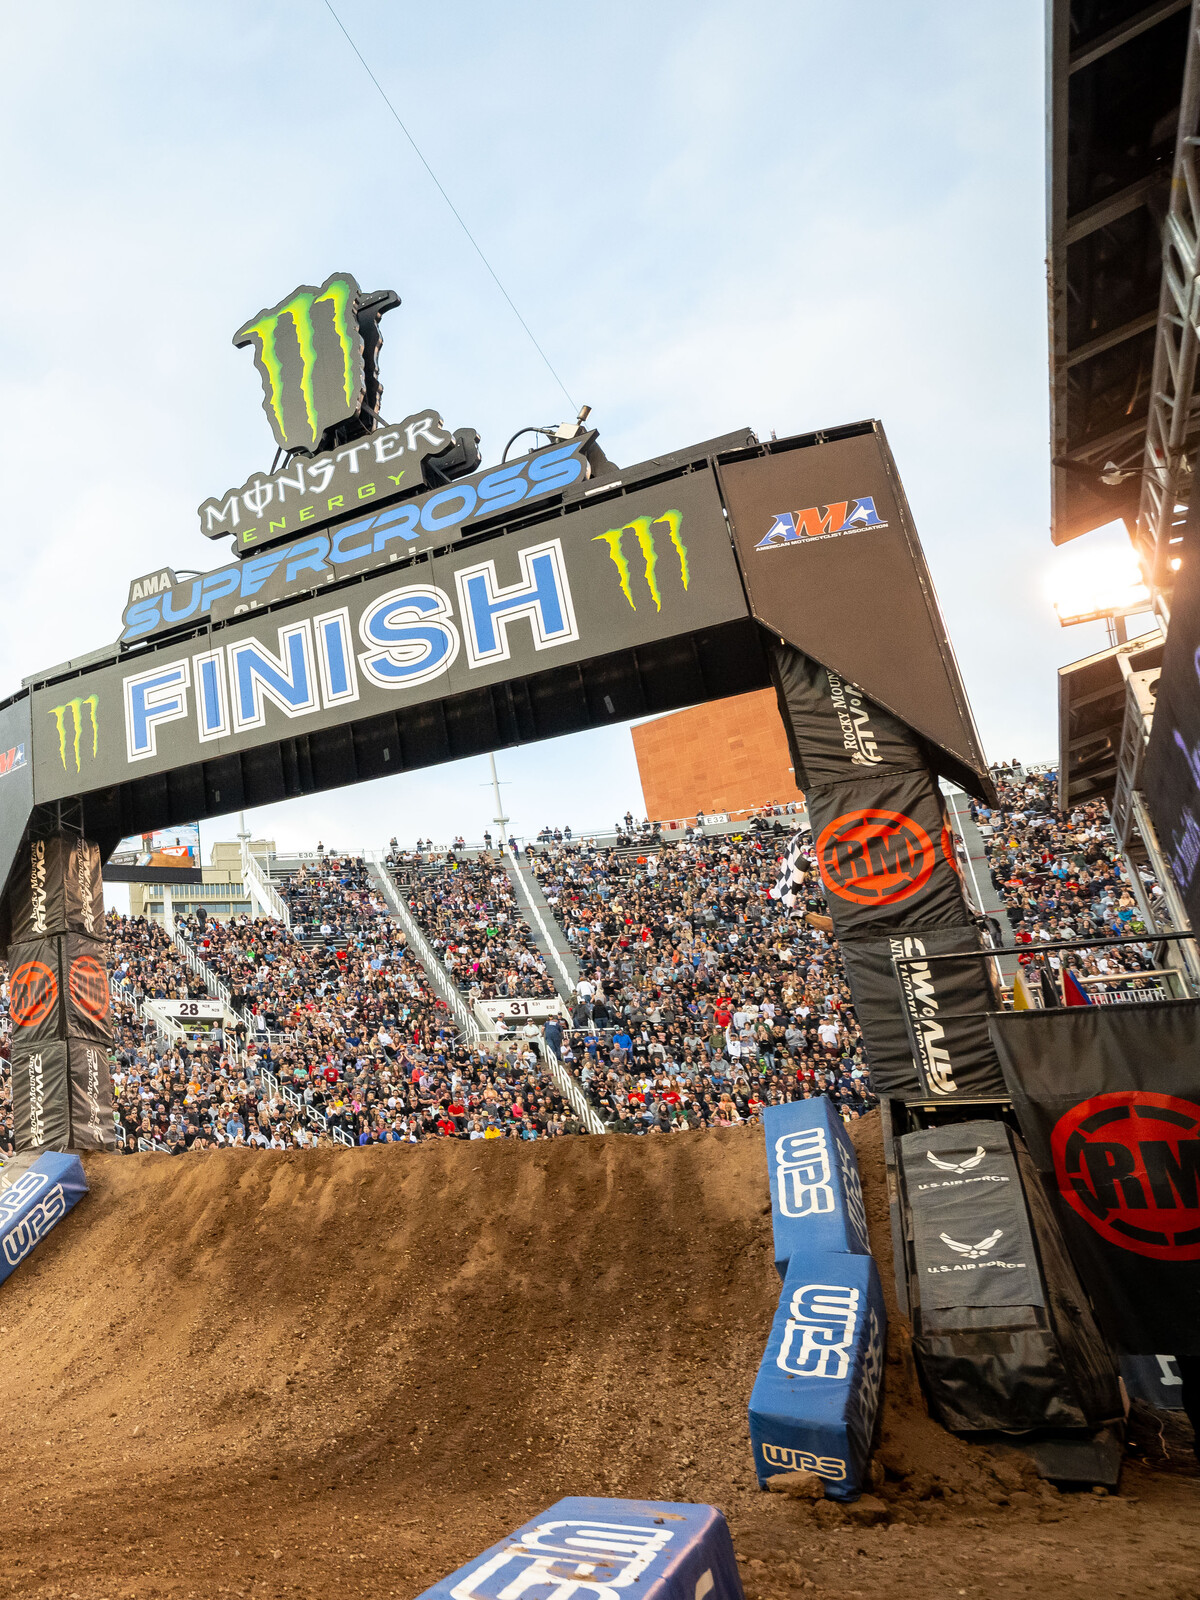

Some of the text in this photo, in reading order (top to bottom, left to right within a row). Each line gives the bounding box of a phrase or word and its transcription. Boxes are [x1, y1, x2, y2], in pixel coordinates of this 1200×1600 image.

[243, 471, 405, 542] ENERGY
[753, 496, 888, 548] AMA
[122, 441, 582, 639] SUPERCROSS
[756, 523, 889, 552] AMERICAN MOTORCYCLIST ASSOCIATION
[132, 572, 171, 602] AMA
[122, 538, 580, 764] FINISH
[838, 711, 859, 750] ROCKY
[1026, 764, 1047, 774] E33
[706, 815, 728, 825] E32
[30, 842, 38, 919] ROCKY MOUNTAIN
[180, 1003, 199, 1015] 28
[510, 1002, 529, 1015] 31
[775, 1127, 835, 1218] WPS
[965, 1175, 1010, 1184] FORCE
[2, 1183, 66, 1266] WPS
[953, 1263, 976, 1271] AIR
[979, 1260, 1026, 1269] FORCE
[776, 1284, 859, 1379] WPS
[762, 1443, 847, 1480] WPS
